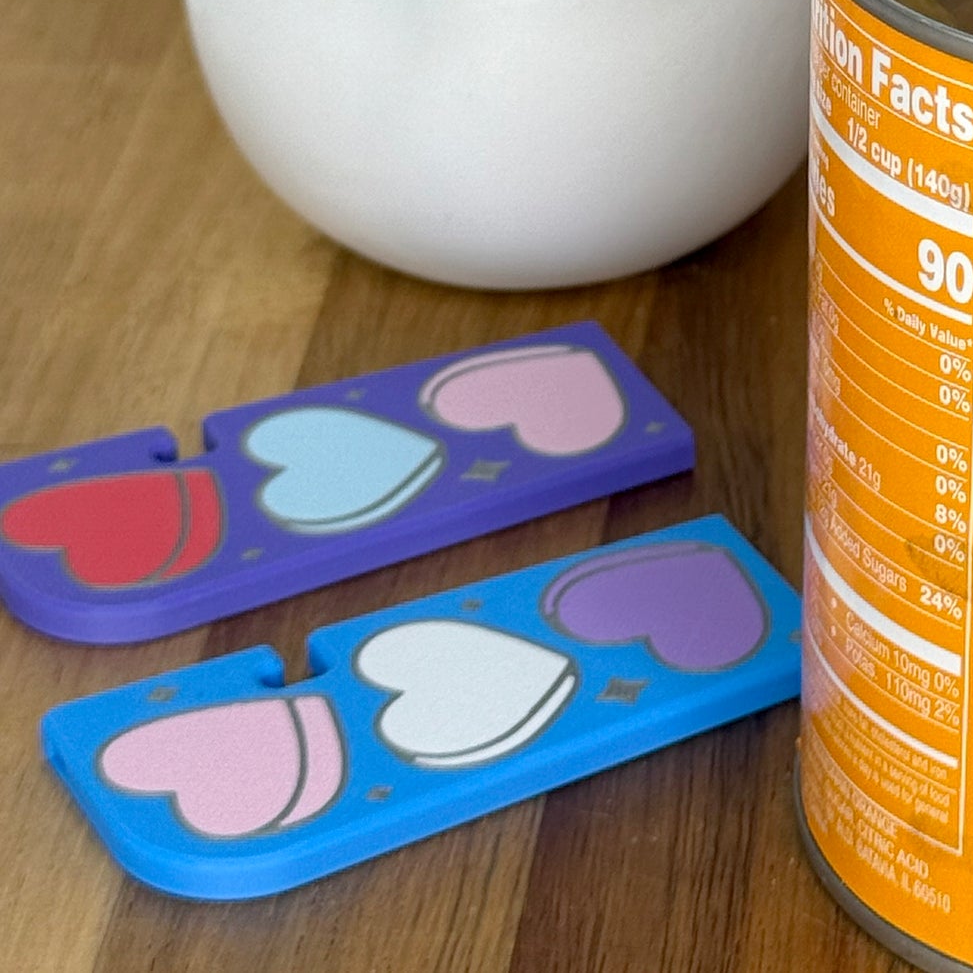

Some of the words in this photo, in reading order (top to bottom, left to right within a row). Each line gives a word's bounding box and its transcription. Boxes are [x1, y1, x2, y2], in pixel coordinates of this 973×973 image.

[831, 73, 882, 130] container
[847, 116, 868, 154] 1/2
[870, 142, 902, 178] cup
[907, 157, 972, 214] (140g)
[896, 305, 927, 337] Daily
[938, 353, 973, 383] 0%
[938, 384, 972, 414] 0%
[858, 456, 881, 492] 21g
[935, 443, 969, 473] 0%
[934, 474, 968, 504] 0%
[933, 503, 968, 534] 8%
[932, 533, 966, 564] 0%
[862, 546, 908, 593] Sugars
[919, 584, 963, 621] 24%
[845, 610, 891, 661] Calcium
[893, 650, 932, 691] 10mg
[933, 671, 960, 698] 0%
[885, 672, 932, 718] 110mg
[934, 699, 960, 726] 2%
